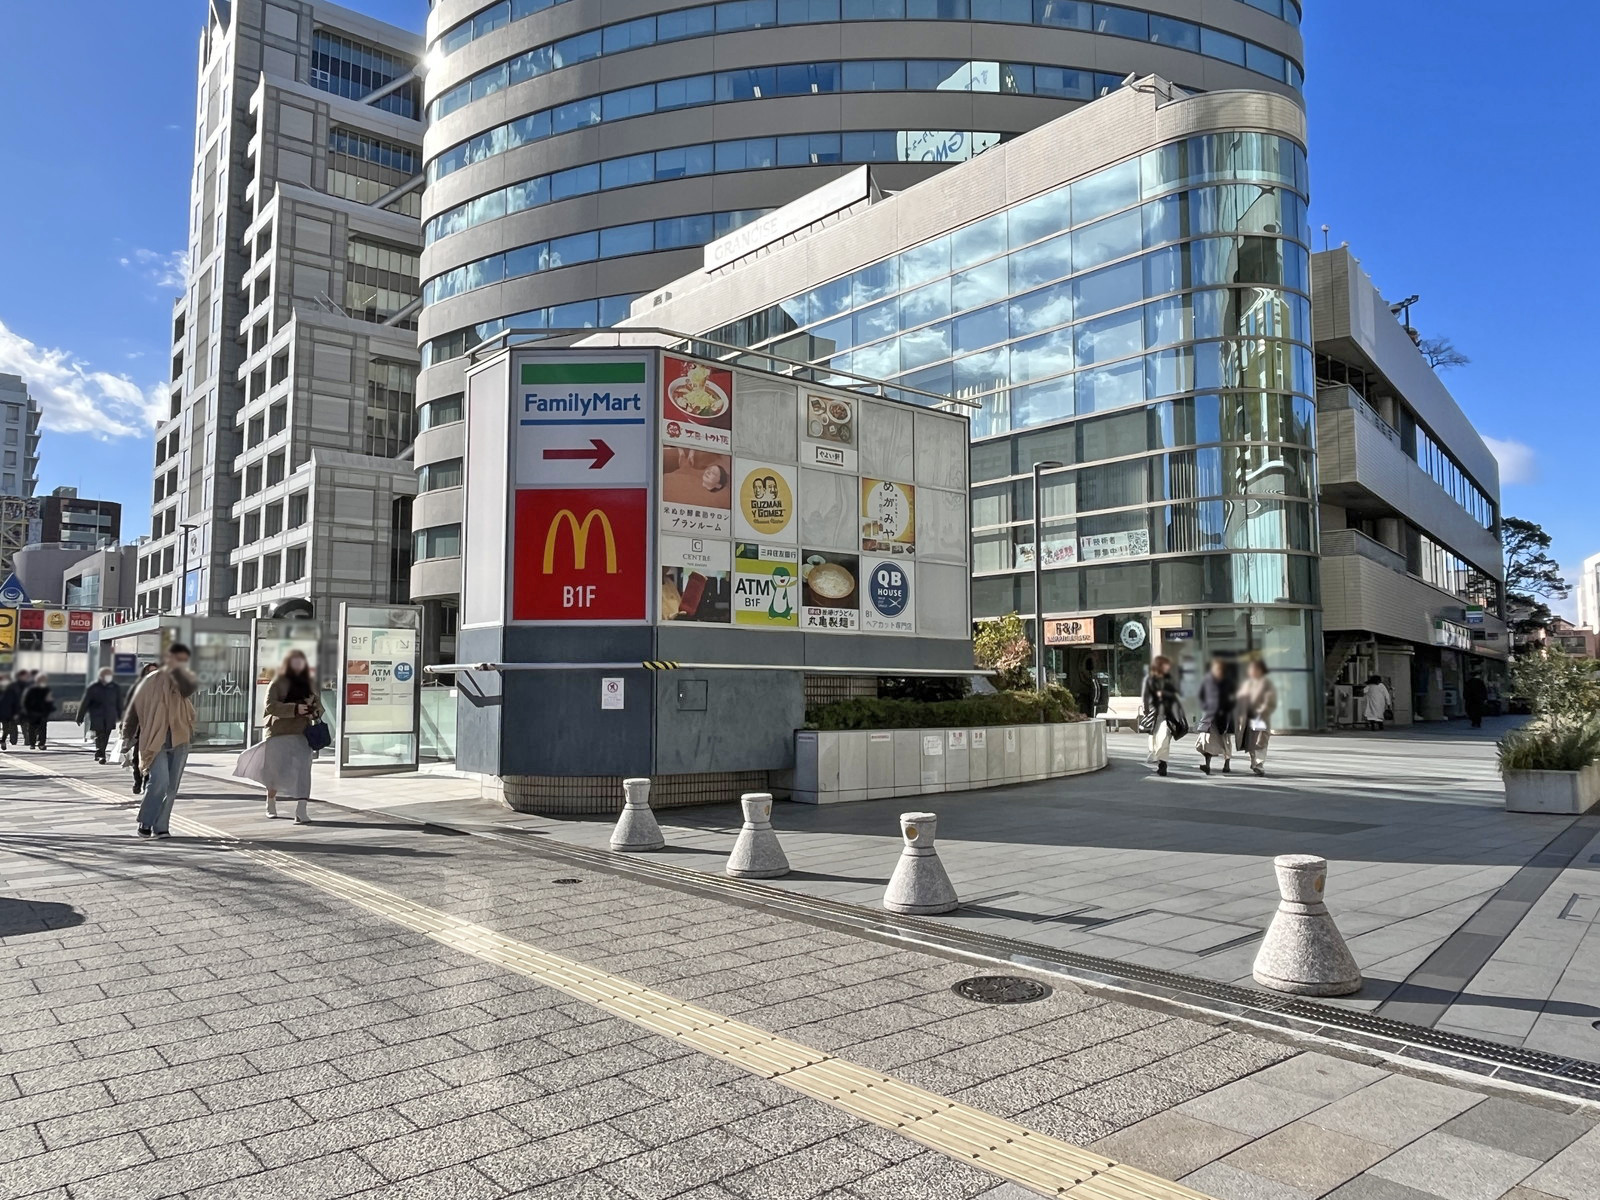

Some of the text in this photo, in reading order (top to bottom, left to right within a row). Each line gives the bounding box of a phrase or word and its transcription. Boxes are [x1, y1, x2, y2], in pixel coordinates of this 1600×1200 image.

[525, 392, 641, 416] FamilyMart
[751, 500, 782, 508] GUZMAN
[752, 509, 784, 518] Y GOMEZ
[883, 482, 895, 539] めがみや
[672, 518, 721, 531] ブランルーム
[682, 553, 711, 561] CENTRE
[760, 549, 796, 558] 三井住友銀行
[877, 570, 902, 588] QB
[735, 578, 770, 596] ATM
[563, 585, 596, 608] B1F
[878, 588, 902, 597] HOUSE
[745, 598, 761, 607] B1F
[865, 610, 872, 618] B1
[808, 616, 848, 628] 丸亀製麺
[866, 621, 912, 630] ヘアカット専門店
[351, 636, 368, 644] B1F
